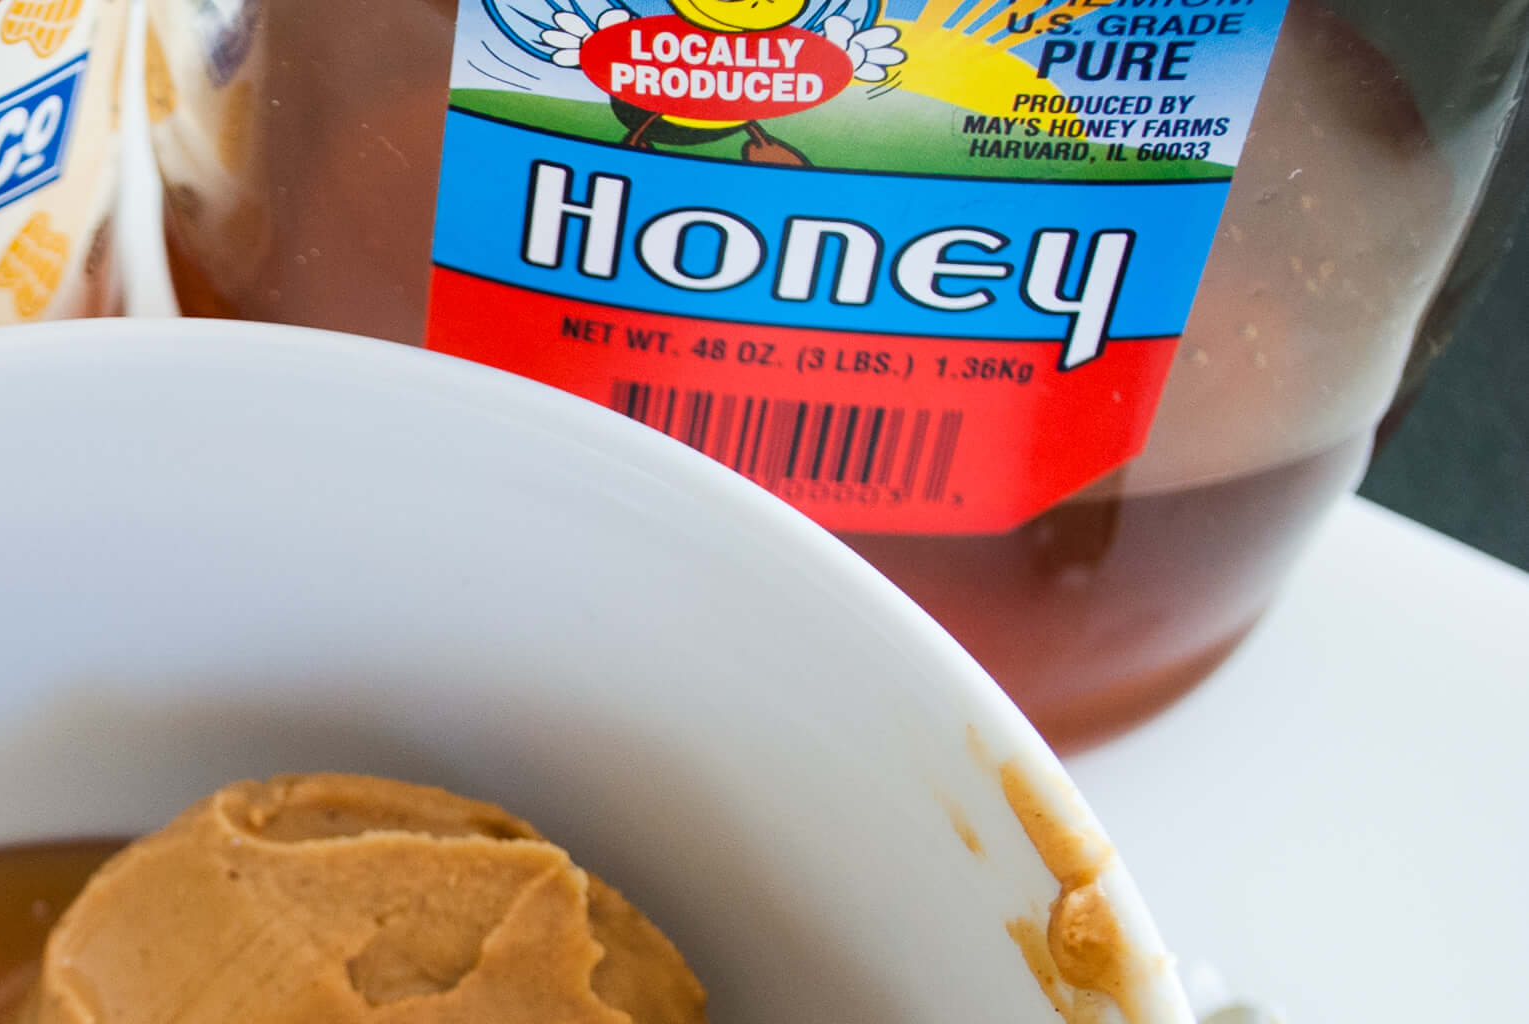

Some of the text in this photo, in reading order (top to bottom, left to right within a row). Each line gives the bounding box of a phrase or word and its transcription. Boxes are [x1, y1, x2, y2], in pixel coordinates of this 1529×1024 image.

[1006, 12, 1246, 36] U.S. GRADE
[630, 29, 805, 68] LOCALLY
[1036, 40, 1196, 81] PURE
[610, 62, 823, 103] PRODUCED
[1013, 94, 1196, 115] PRODUCED BY
[962, 116, 1231, 138] MAY'S HONEY FARMS
[969, 139, 1211, 163] HARVARD, IL 60033
[559, 315, 617, 346] NET
[626, 329, 679, 357] WT.
[691, 337, 727, 361] 48
[737, 342, 784, 368] OZ.
[796, 347, 824, 375] (3
[834, 352, 914, 380] LBS.)
